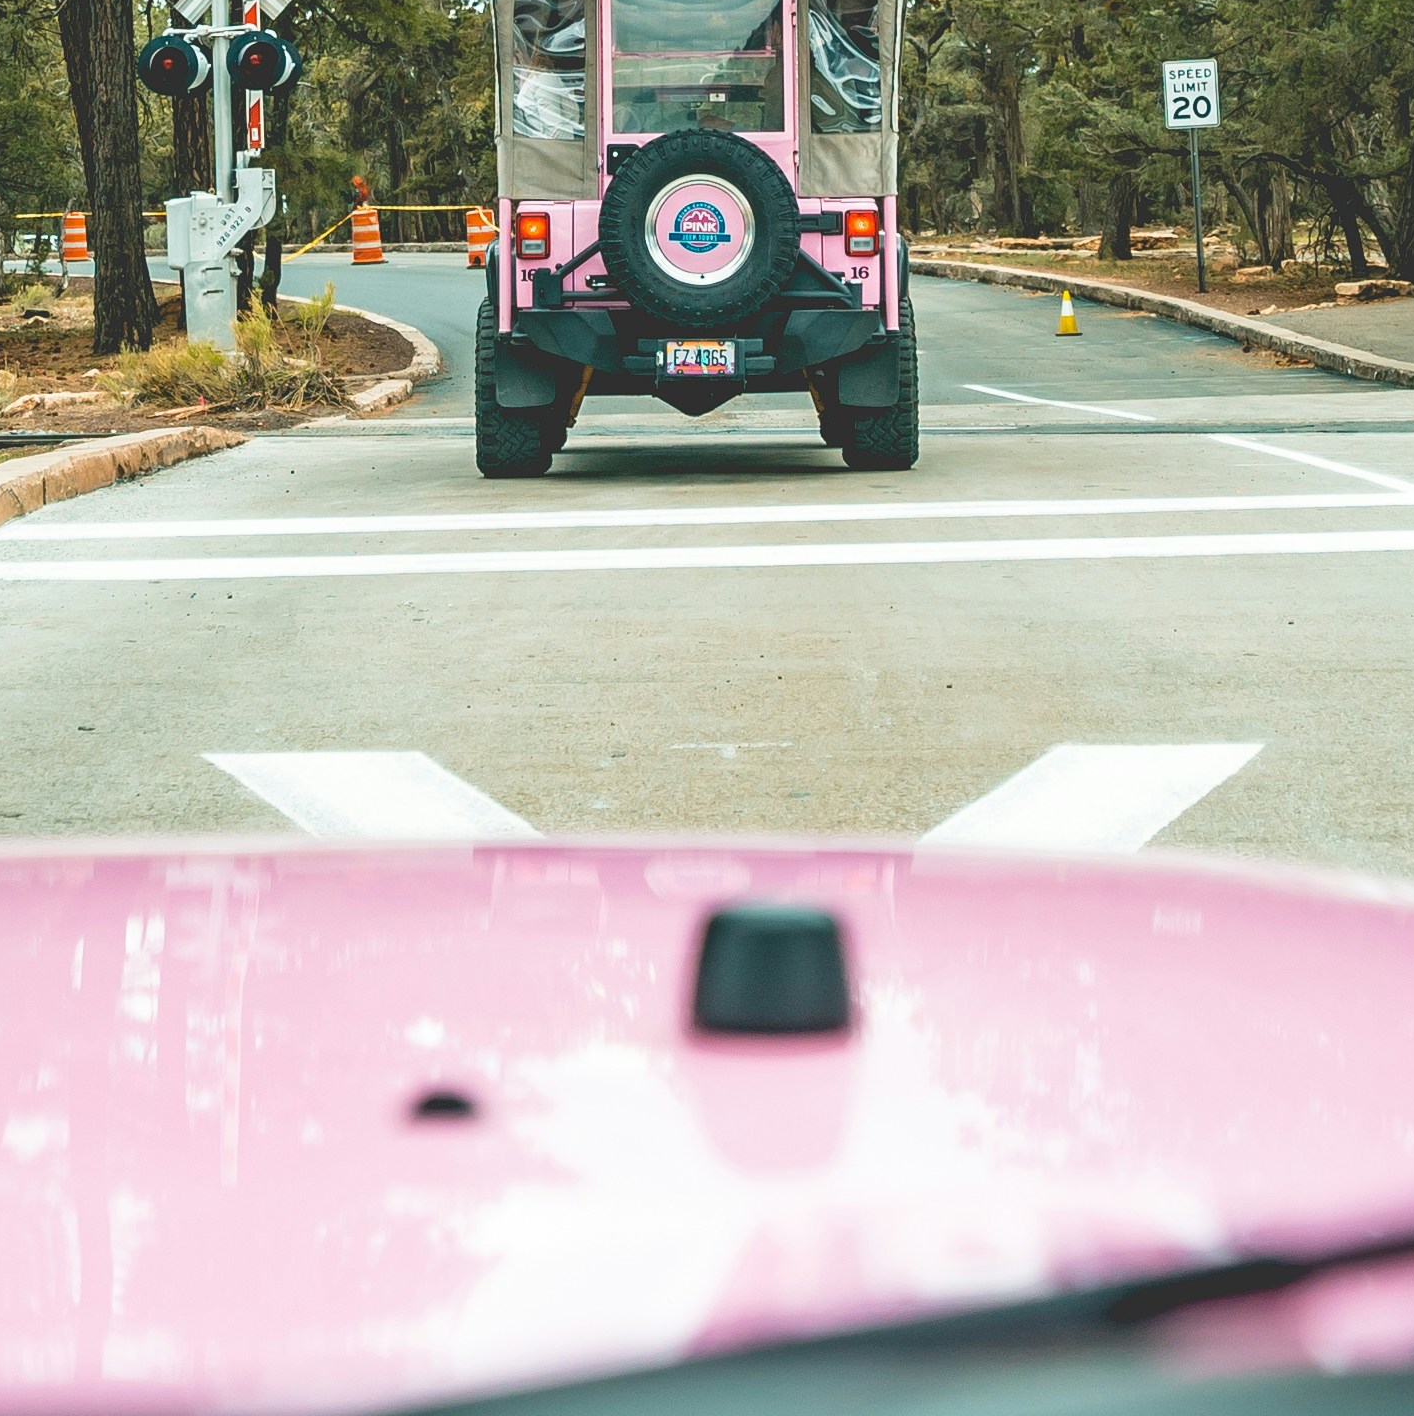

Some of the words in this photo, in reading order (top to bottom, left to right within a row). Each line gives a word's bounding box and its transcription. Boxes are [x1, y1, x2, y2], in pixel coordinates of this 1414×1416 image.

[1169, 68, 1212, 80] SPEED
[1173, 82, 1208, 93] LIMIT
[1172, 95, 1212, 120] 20
[683, 221, 717, 232] PINK
[851, 266, 870, 280] 16
